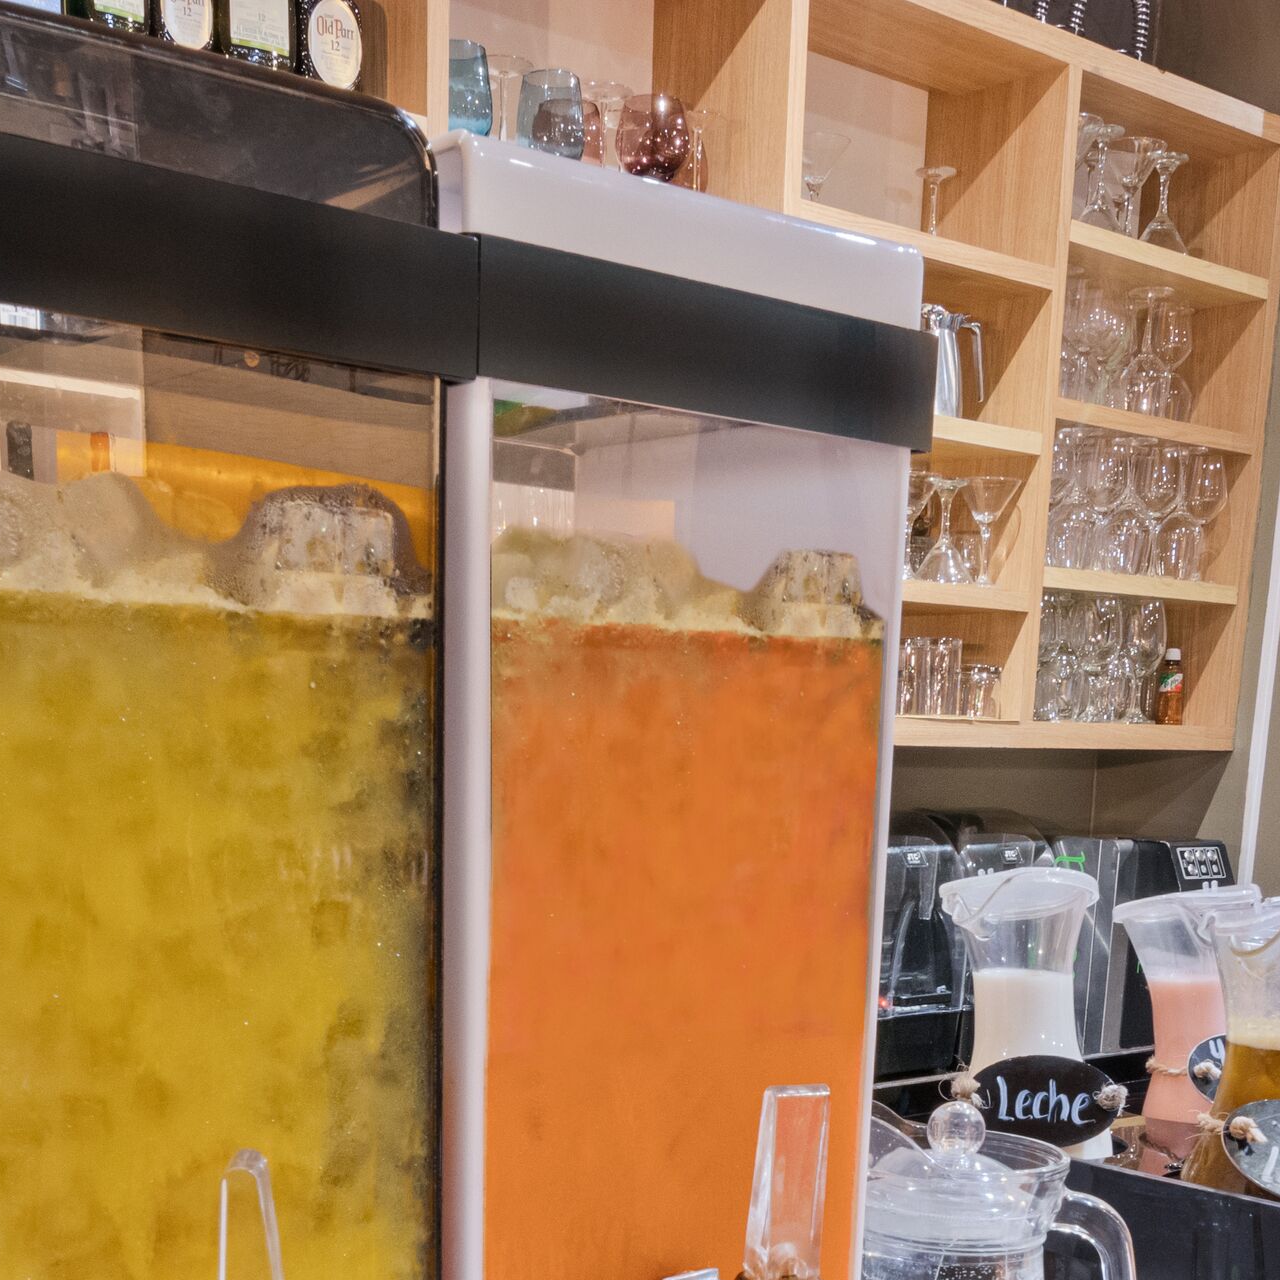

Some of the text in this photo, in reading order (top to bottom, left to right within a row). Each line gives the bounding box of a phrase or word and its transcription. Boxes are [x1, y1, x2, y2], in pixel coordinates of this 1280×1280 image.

[183, 6, 192, 17] 12
[317, 15, 354, 40] Old Parr
[331, 40, 340, 51] 12
[996, 1076, 1096, 1125] Leche
